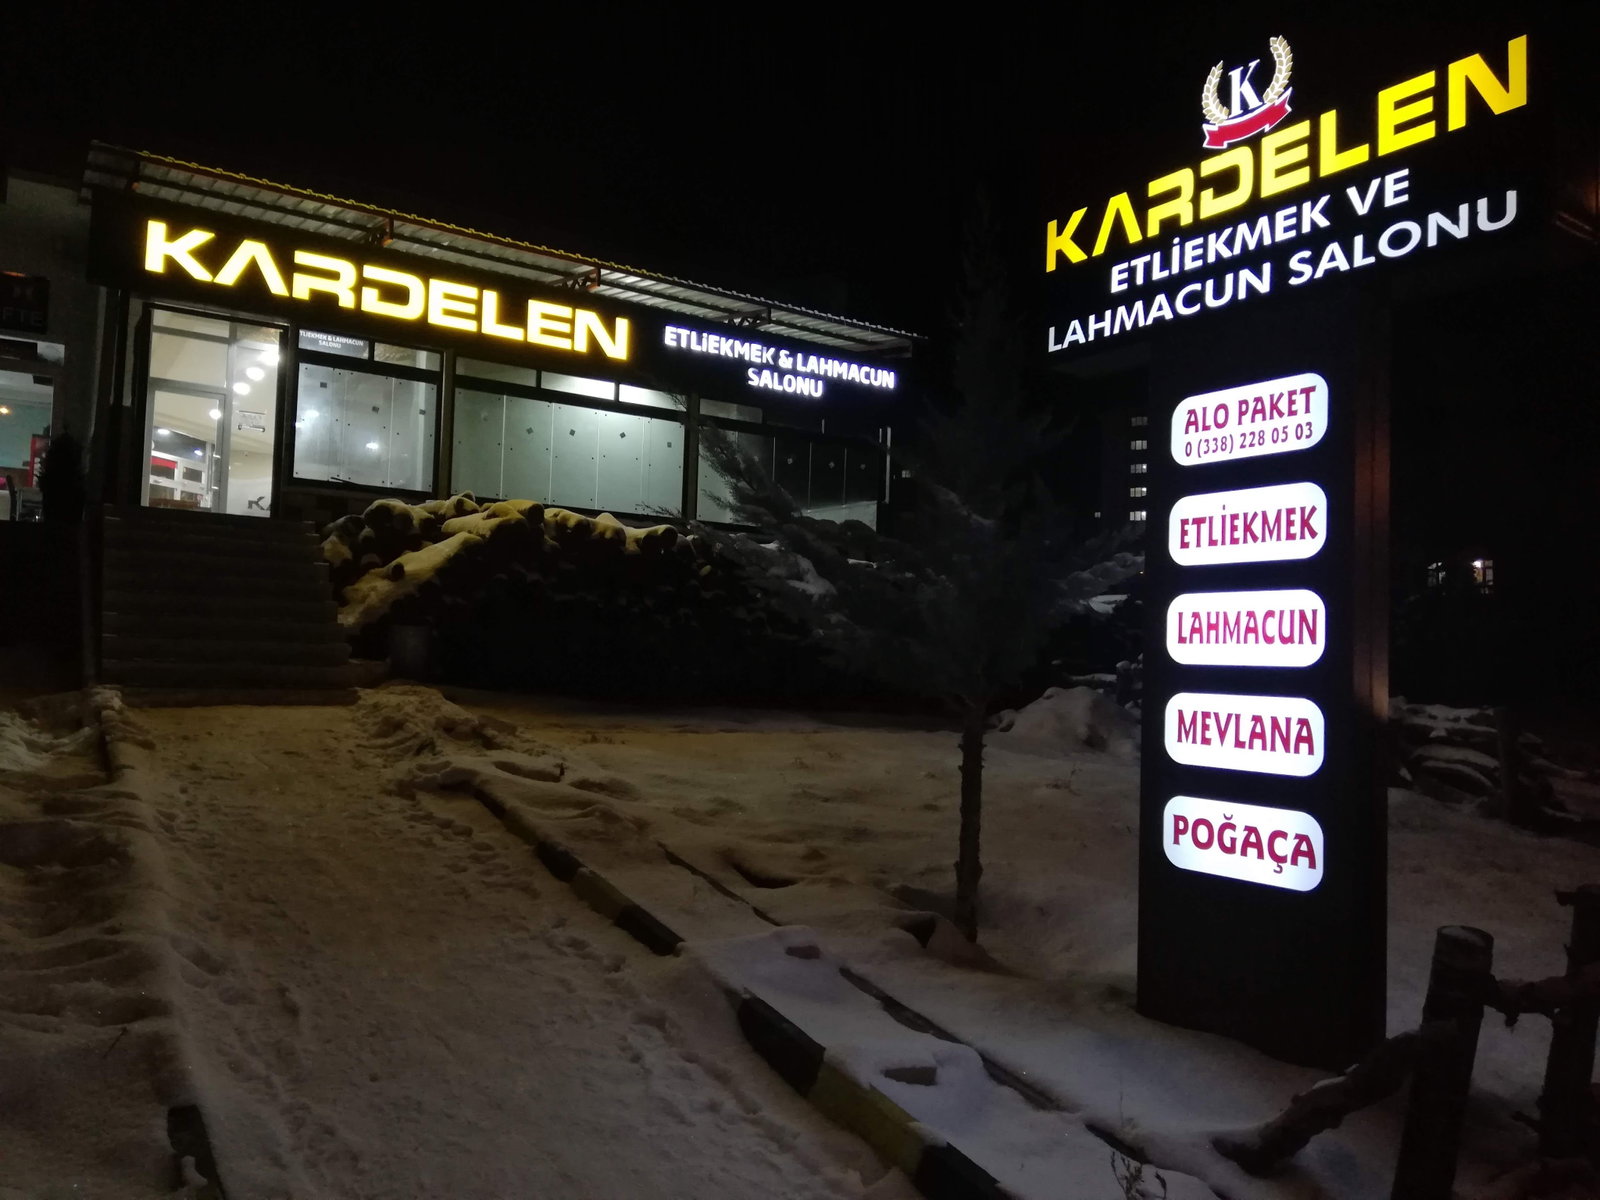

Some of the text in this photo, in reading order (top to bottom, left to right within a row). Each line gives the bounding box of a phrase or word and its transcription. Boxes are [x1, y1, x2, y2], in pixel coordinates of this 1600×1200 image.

[1228, 58, 1264, 119] K
[1045, 34, 1528, 273] KARDELEN
[1110, 168, 1410, 294] ETLİEKMEK VE
[144, 218, 629, 361] KARDELEN
[1048, 190, 1518, 352] LAHMACUN SALONU
[747, 367, 824, 398] SALONU
[778, 349, 794, 369] &
[796, 352, 896, 389] LAHMACUN
[1184, 385, 1317, 435] ALO PAKET
[1184, 421, 1313, 458] 0 (338) 228 05 03
[1179, 504, 1319, 549] ETLİEKMEK
[1177, 608, 1318, 645] LAHMACUN
[1176, 709, 1315, 756] MEVLANA
[1172, 813, 1317, 874] POĞAÇA
